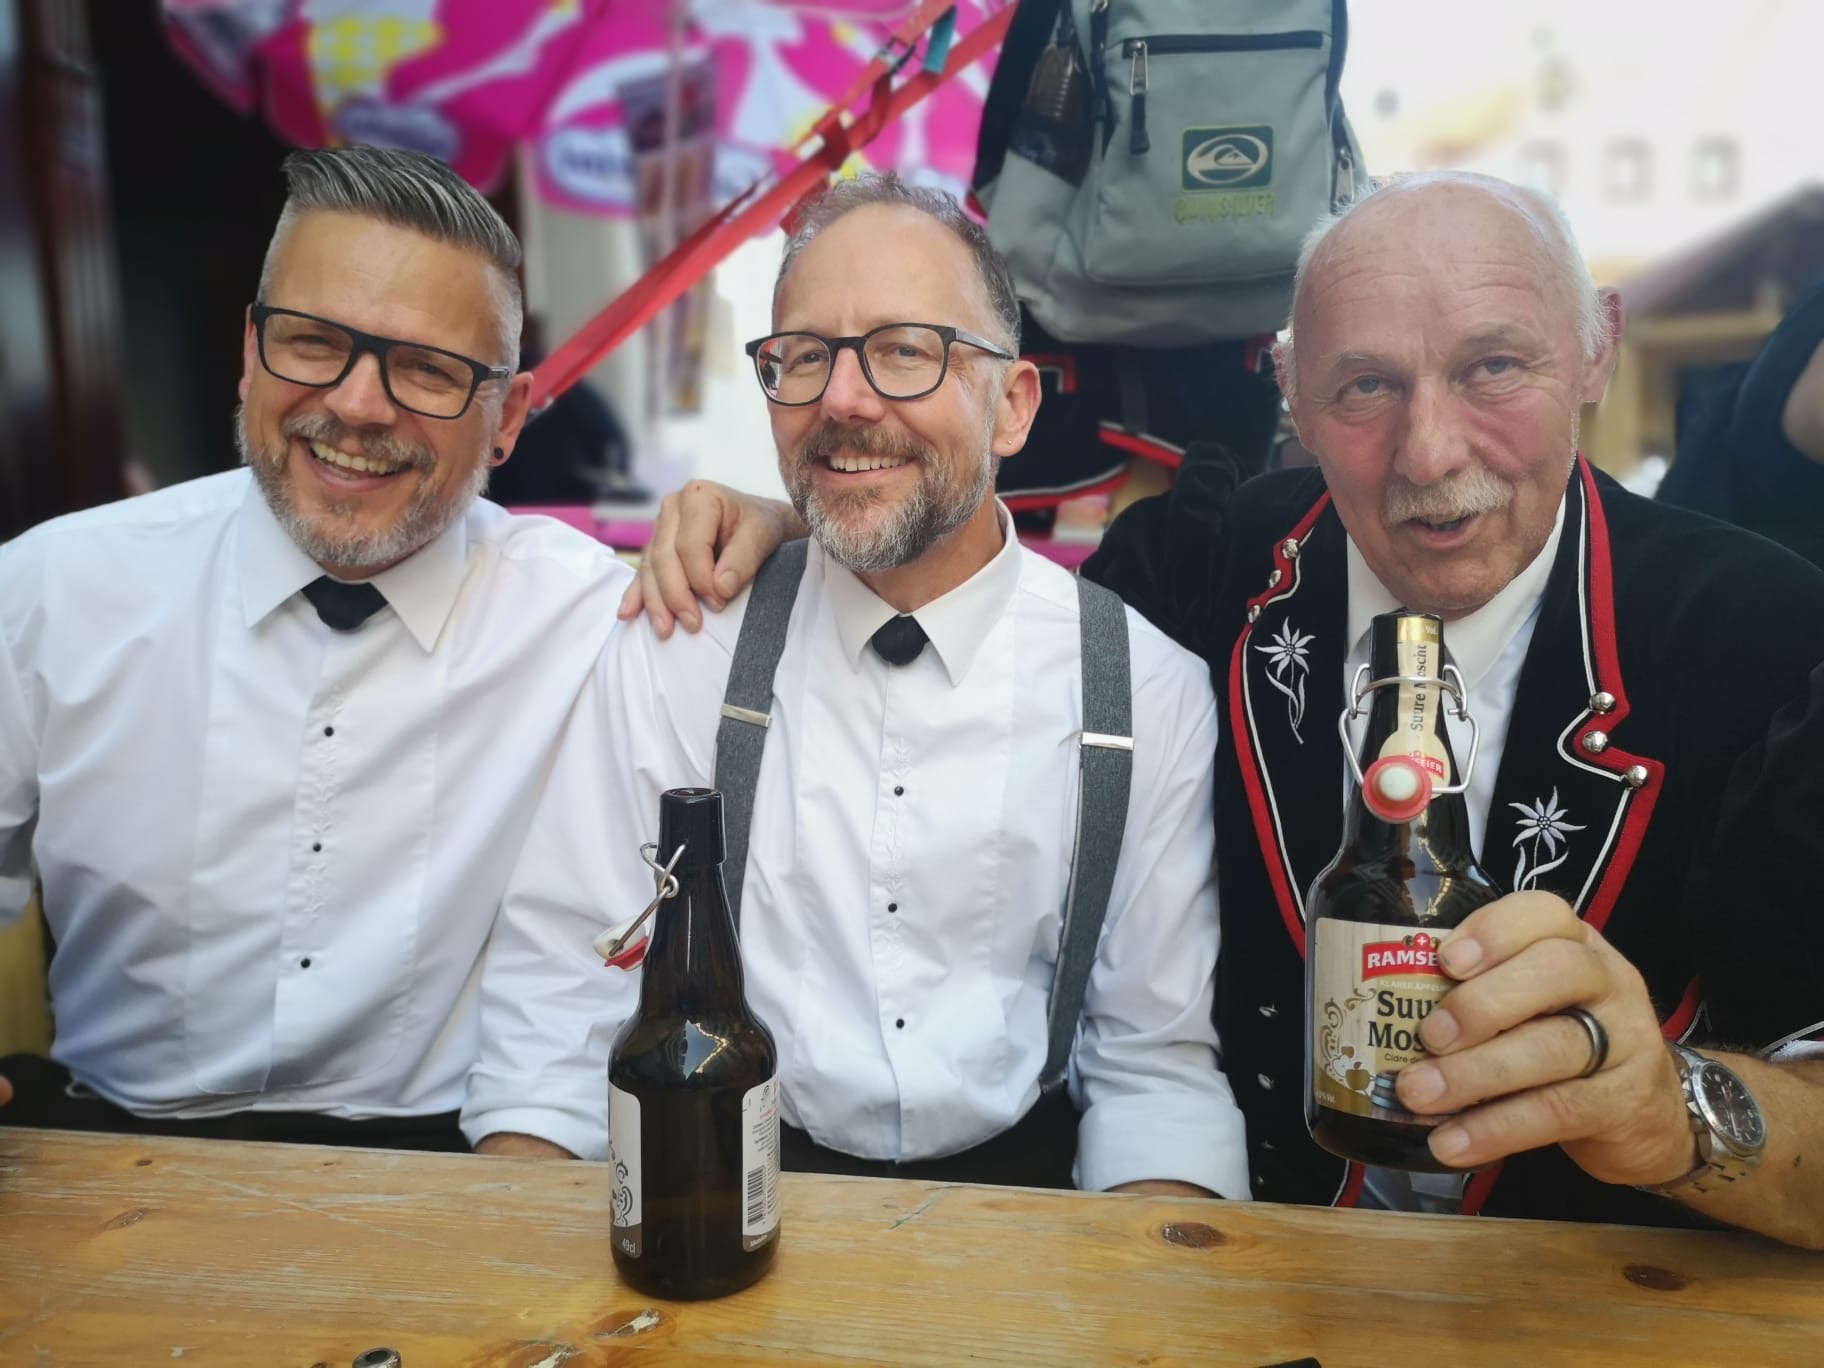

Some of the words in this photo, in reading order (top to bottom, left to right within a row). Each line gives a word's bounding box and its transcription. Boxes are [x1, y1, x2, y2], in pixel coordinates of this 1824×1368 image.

[1410, 693, 1426, 731] Suure
[1367, 950, 1438, 969] RAMSE
[1377, 991, 1438, 1020] Suu
[1368, 1020, 1426, 1053] Mos
[1384, 1053, 1409, 1063] Cidre
